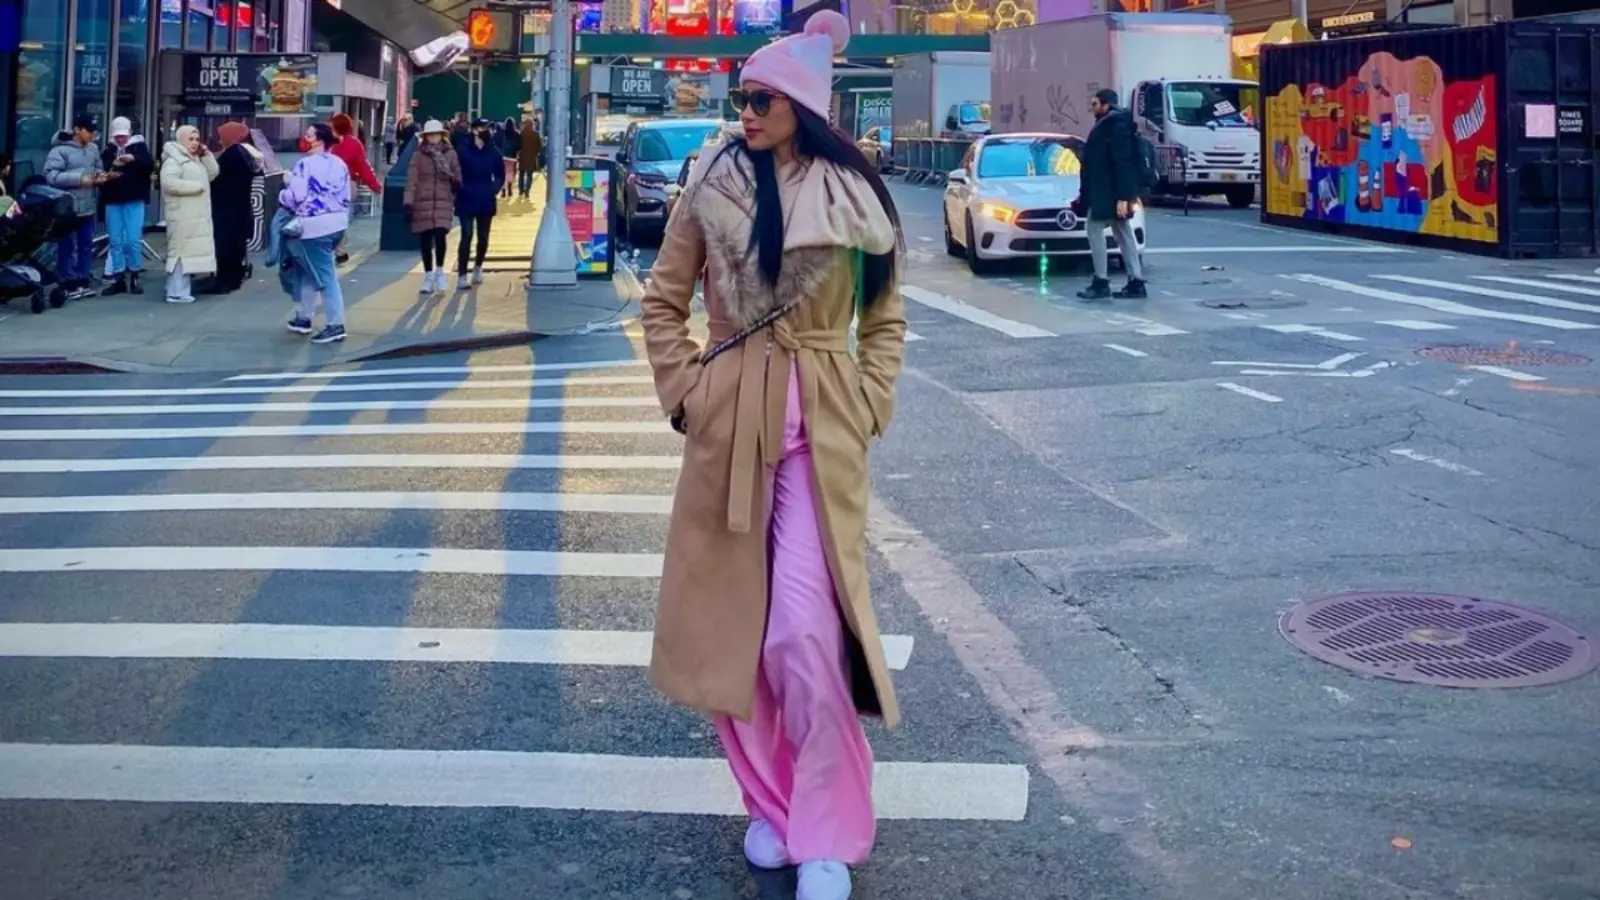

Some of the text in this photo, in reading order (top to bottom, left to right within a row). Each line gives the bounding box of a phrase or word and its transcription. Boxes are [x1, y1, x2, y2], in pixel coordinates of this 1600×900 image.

[201, 57, 238, 69] WE ARE
[200, 69, 238, 87] OPEN
[623, 70, 651, 79] WE ARE
[622, 79, 652, 93] OPEN
[1558, 118, 1583, 126] SQUARE
